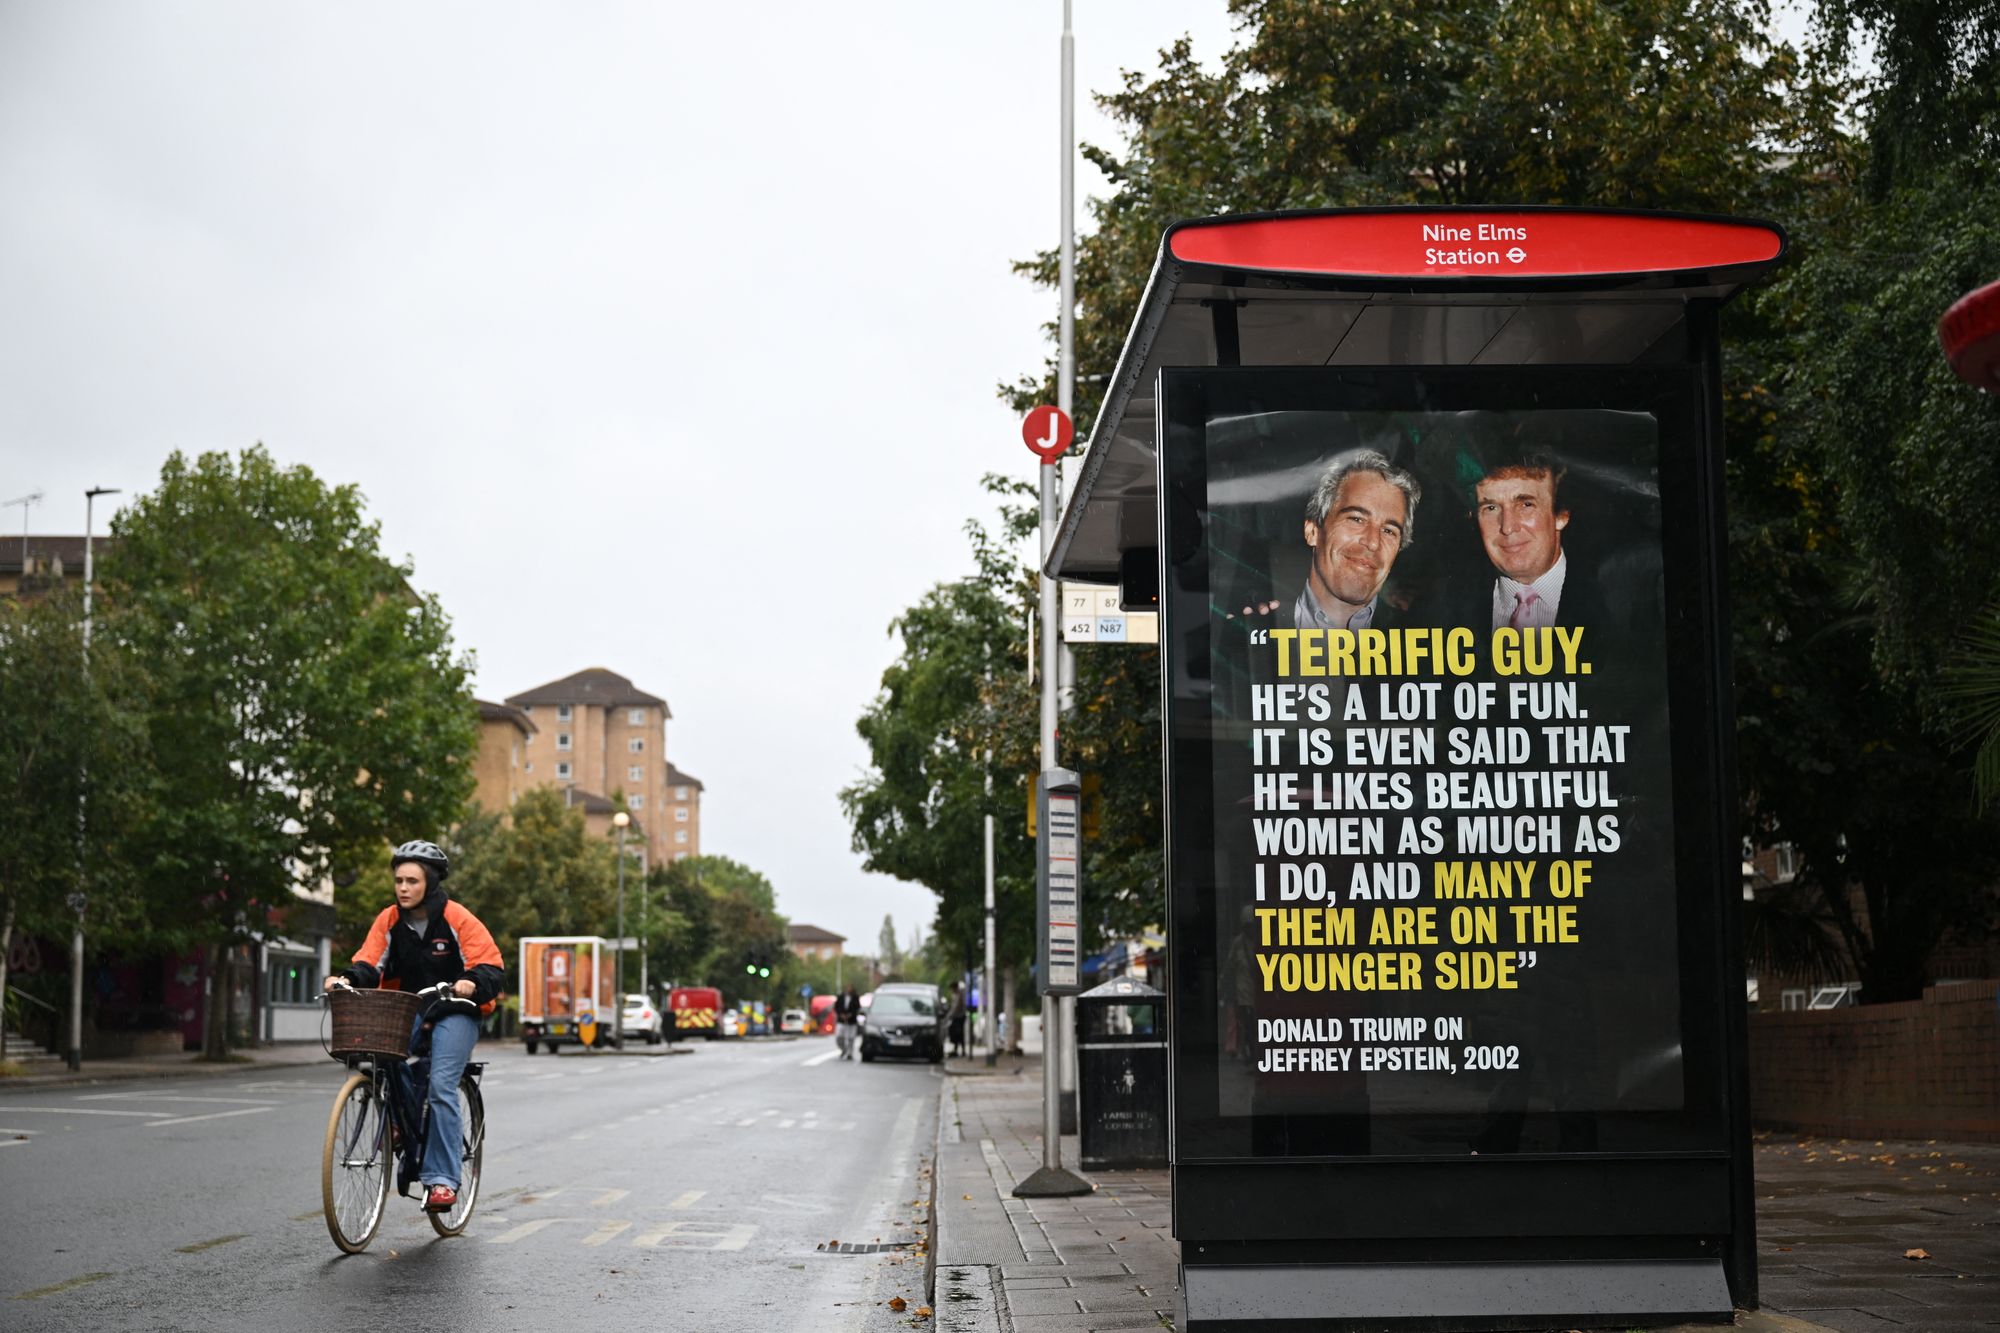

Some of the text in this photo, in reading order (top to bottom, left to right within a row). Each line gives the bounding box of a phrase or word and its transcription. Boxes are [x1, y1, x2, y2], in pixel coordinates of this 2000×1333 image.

[1422, 223, 1527, 241] Nine Elms
[1425, 248, 1500, 265] Station
[1036, 412, 1059, 449] J
[1073, 598, 1117, 607] 77 87
[1071, 623, 1122, 633] 452 N87
[1250, 626, 1592, 677] “TERRIFIC GUY.
[1252, 682, 1589, 722] HE’S A LOT OF FUN.
[1253, 726, 1631, 766] IT IS EVEN SAID THAT
[1253, 771, 1619, 811] HE LIKES BEAUTIFUL
[1252, 815, 1621, 856] WOMEN AS MUCH AS
[1256, 860, 1592, 909] I DO, AND MANY OF
[1254, 905, 1579, 947] THEM ARE ON THE
[1255, 951, 1537, 992] YOUNGER SIDE”
[1257, 1017, 1463, 1043] DONALD TRUMP ON
[1257, 1045, 1520, 1075] JEFFREY EPSTEIN, 2002
